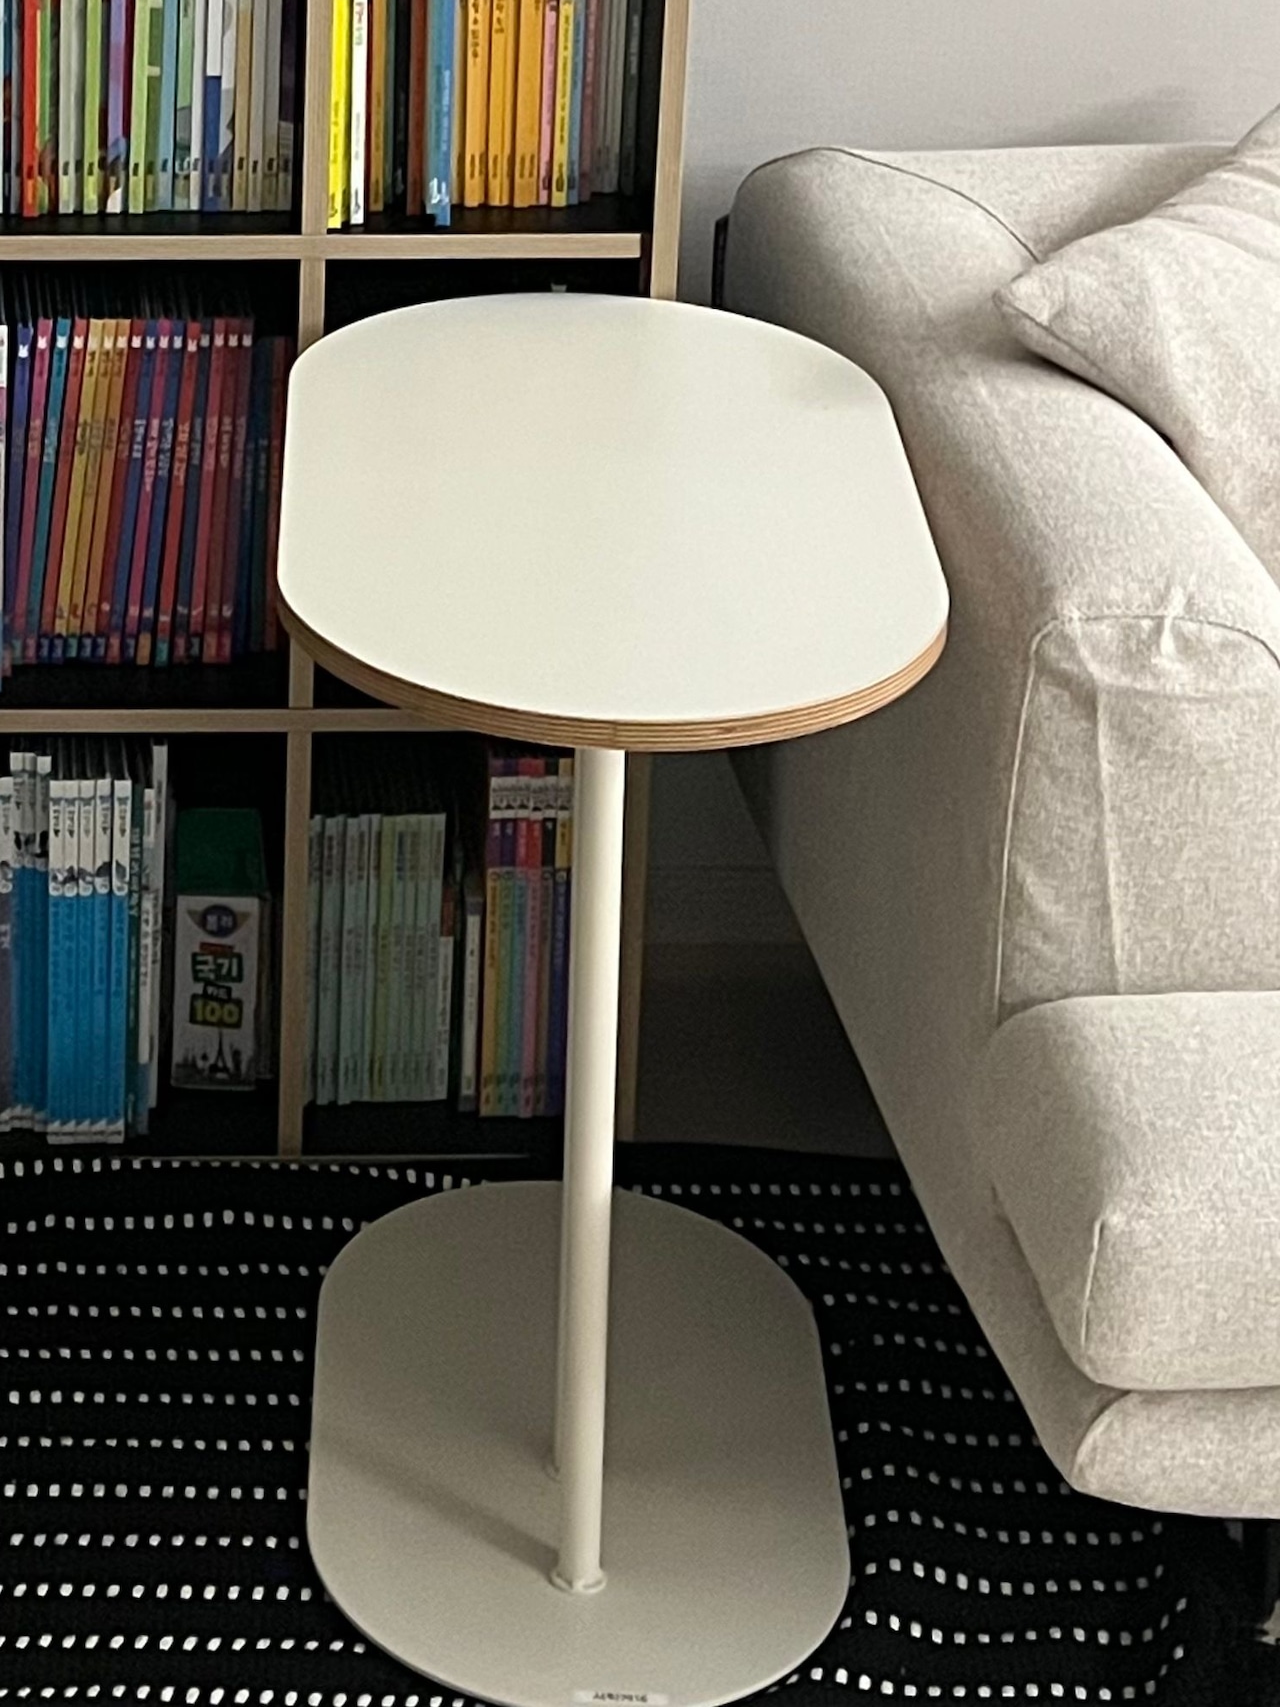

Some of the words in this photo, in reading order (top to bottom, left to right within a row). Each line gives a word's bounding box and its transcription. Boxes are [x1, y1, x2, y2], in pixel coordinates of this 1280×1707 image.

[195, 955, 239, 980] 국기
[206, 985, 229, 999] 카드
[194, 999, 240, 1025] 100
